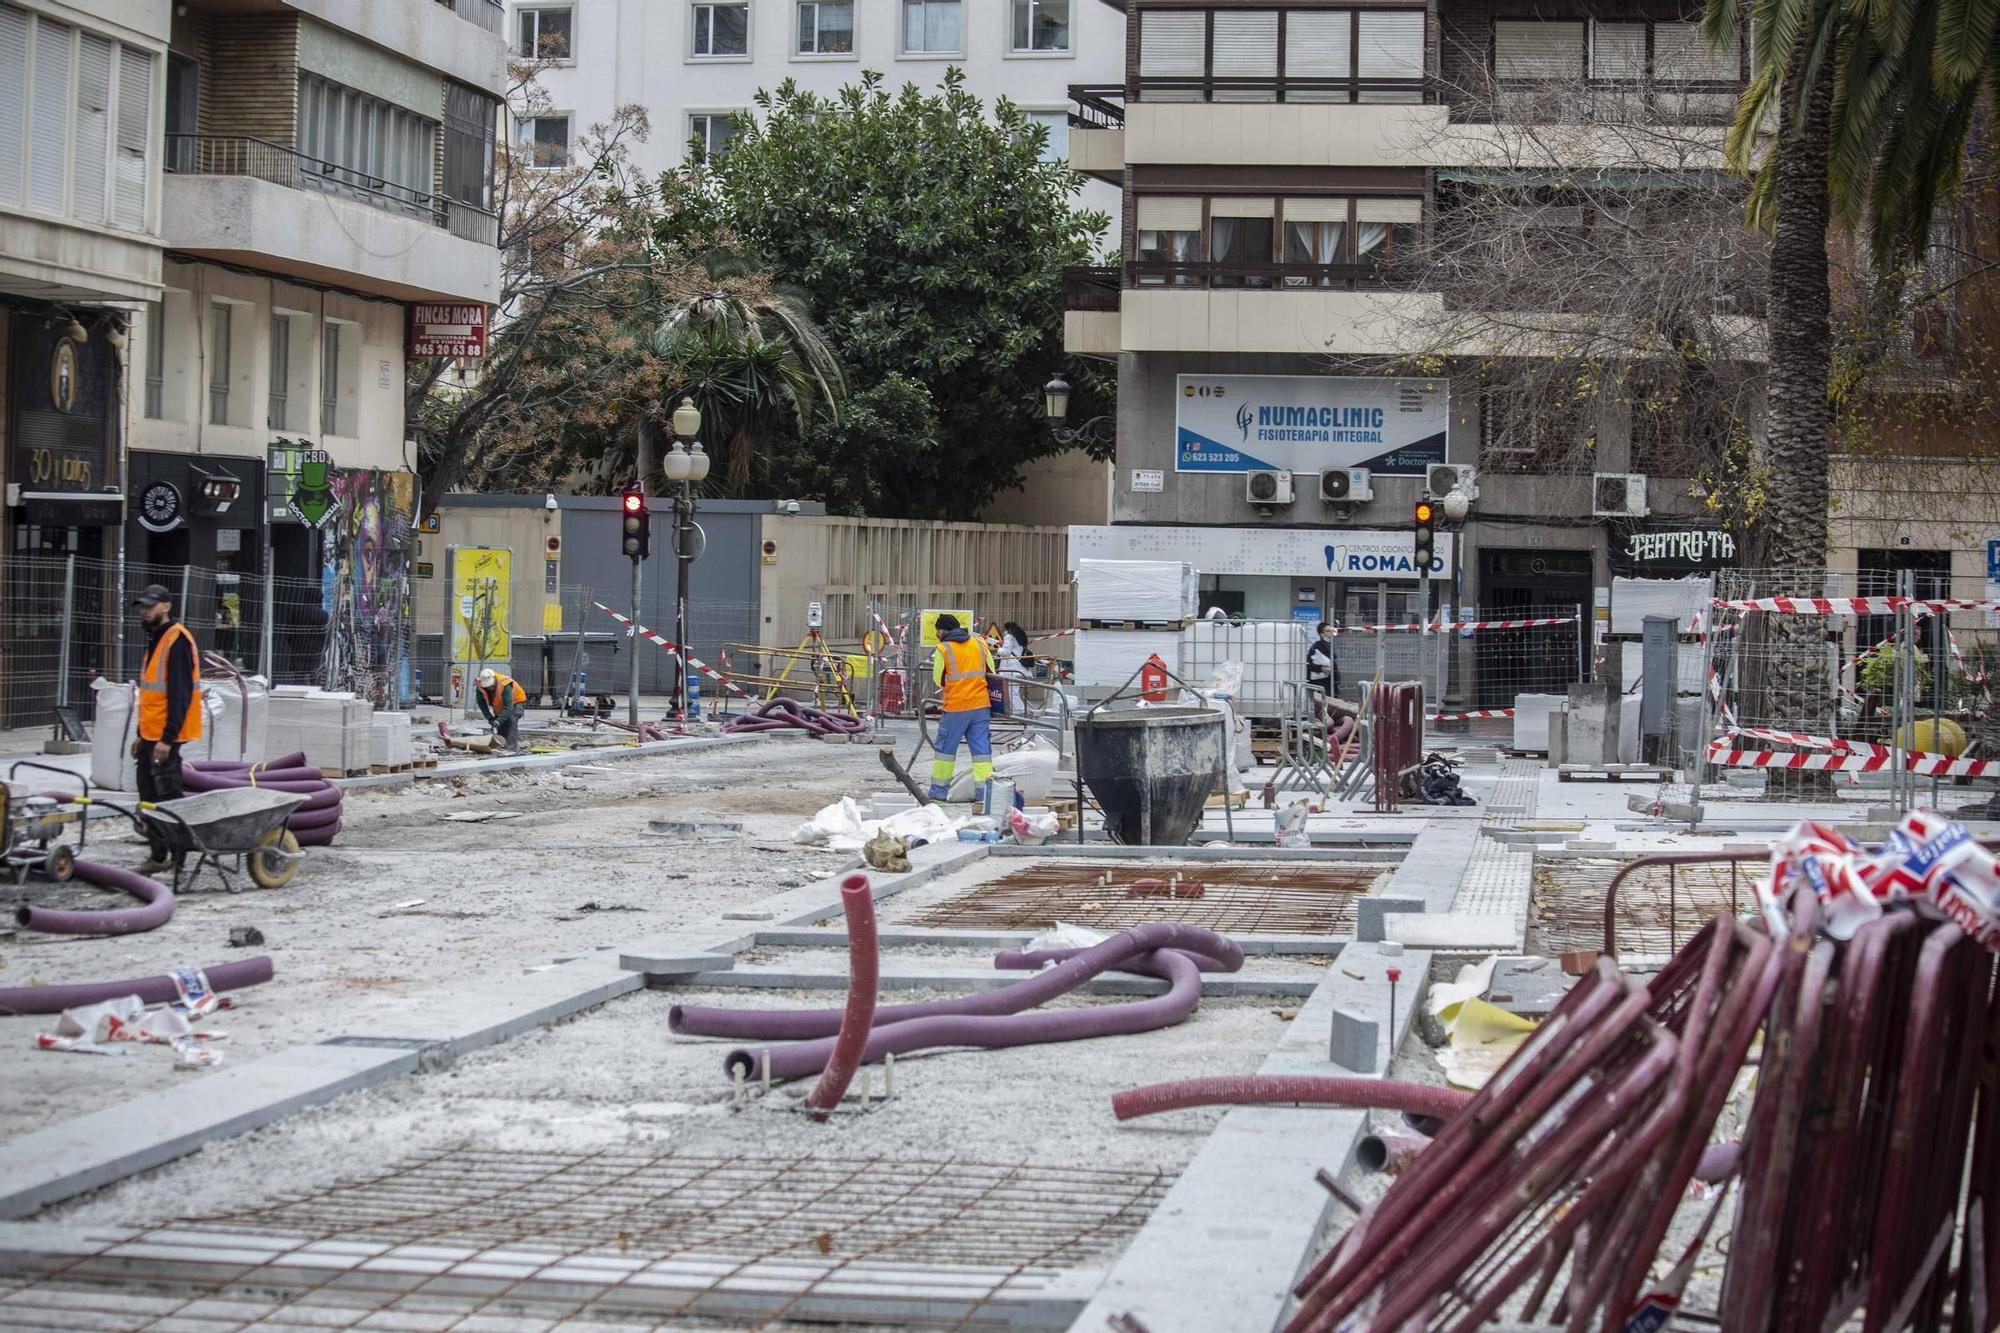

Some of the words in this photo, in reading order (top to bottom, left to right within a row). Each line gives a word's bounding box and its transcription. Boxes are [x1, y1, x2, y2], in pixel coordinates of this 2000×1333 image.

[415, 306, 450, 324] FINCAS
[452, 307, 482, 324] MORA
[415, 343, 434, 355] 965
[436, 344, 450, 355] 20
[452, 344, 465, 356] 63
[467, 345, 481, 356] 88
[1258, 406, 1384, 428] NUMACLINIC
[1258, 429, 1329, 442] FISIOTERAPIA
[1333, 430, 1383, 443] INTEGRAL
[304, 451, 326, 463] CBD
[288, 501, 312, 529] DOCTOR
[1348, 545, 1380, 553] CENTROS
